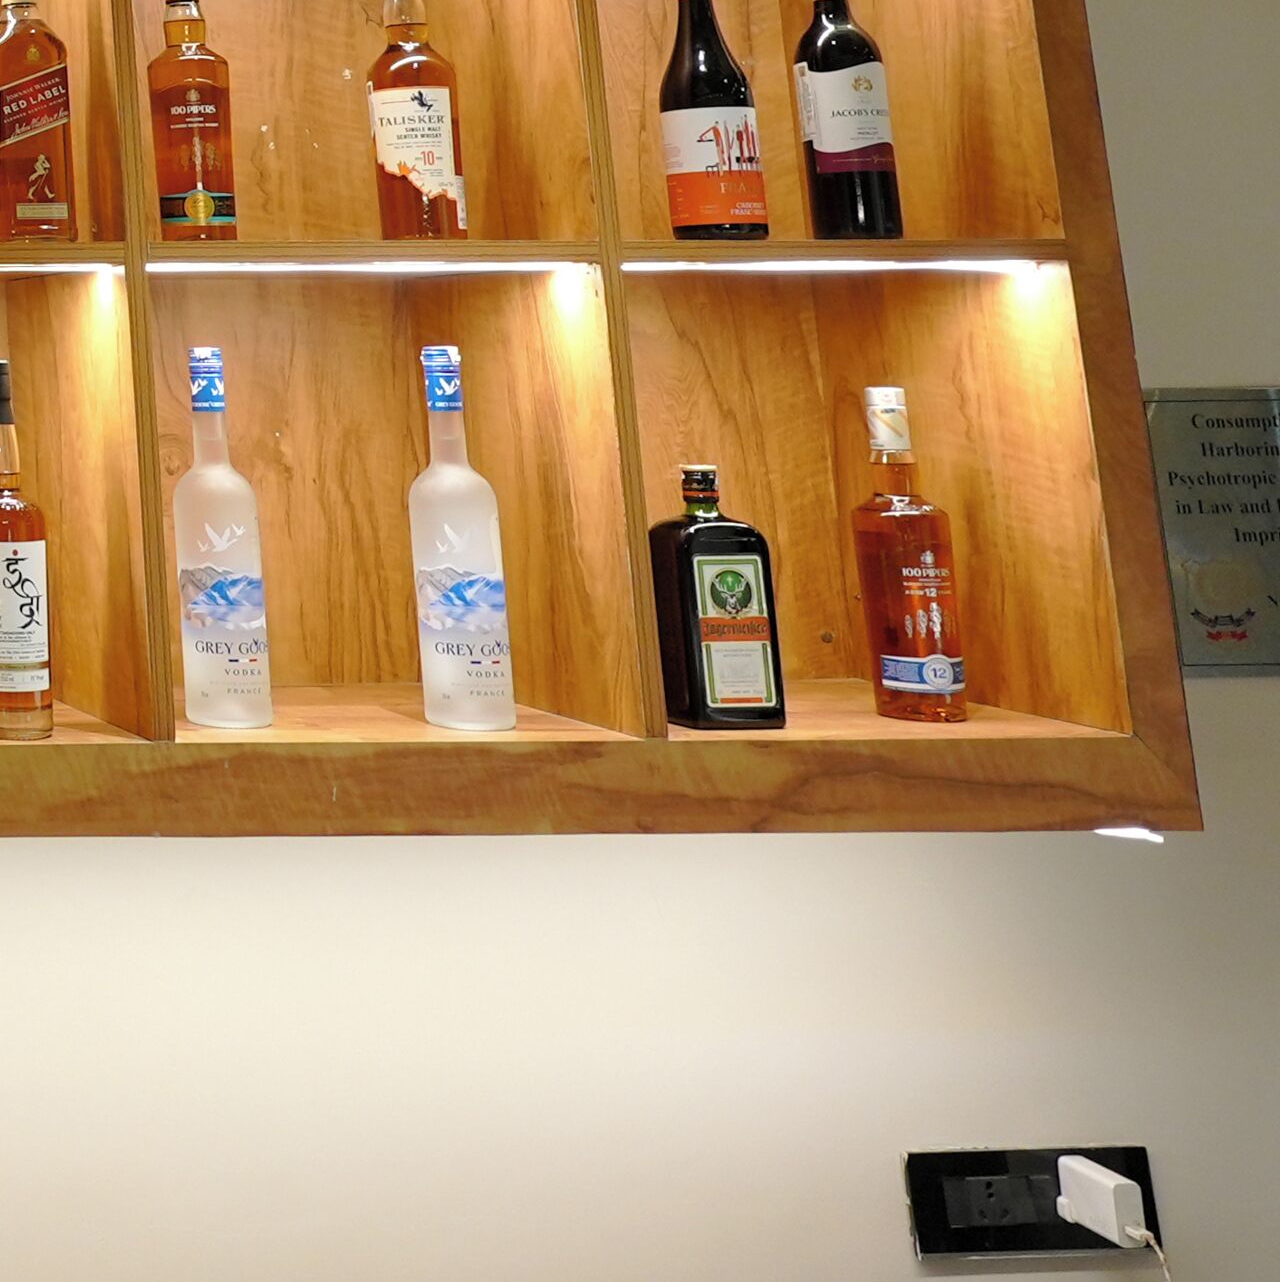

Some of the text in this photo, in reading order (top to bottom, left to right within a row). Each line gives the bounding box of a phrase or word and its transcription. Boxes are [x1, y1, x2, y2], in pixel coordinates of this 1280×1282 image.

[3, 84, 67, 116] RED LABEL
[830, 109, 869, 119] JACOB'S
[379, 115, 447, 128] TALISKER
[421, 150, 435, 166] 10
[1167, 470, 1277, 490] Psychotropic
[1176, 498, 1271, 515] in Law and
[902, 567, 921, 577] 100
[924, 587, 937, 597] 12
[194, 640, 234, 655] GREY
[434, 641, 476, 656] GREY
[225, 668, 262, 676] VODKA
[930, 668, 948, 679] 12
